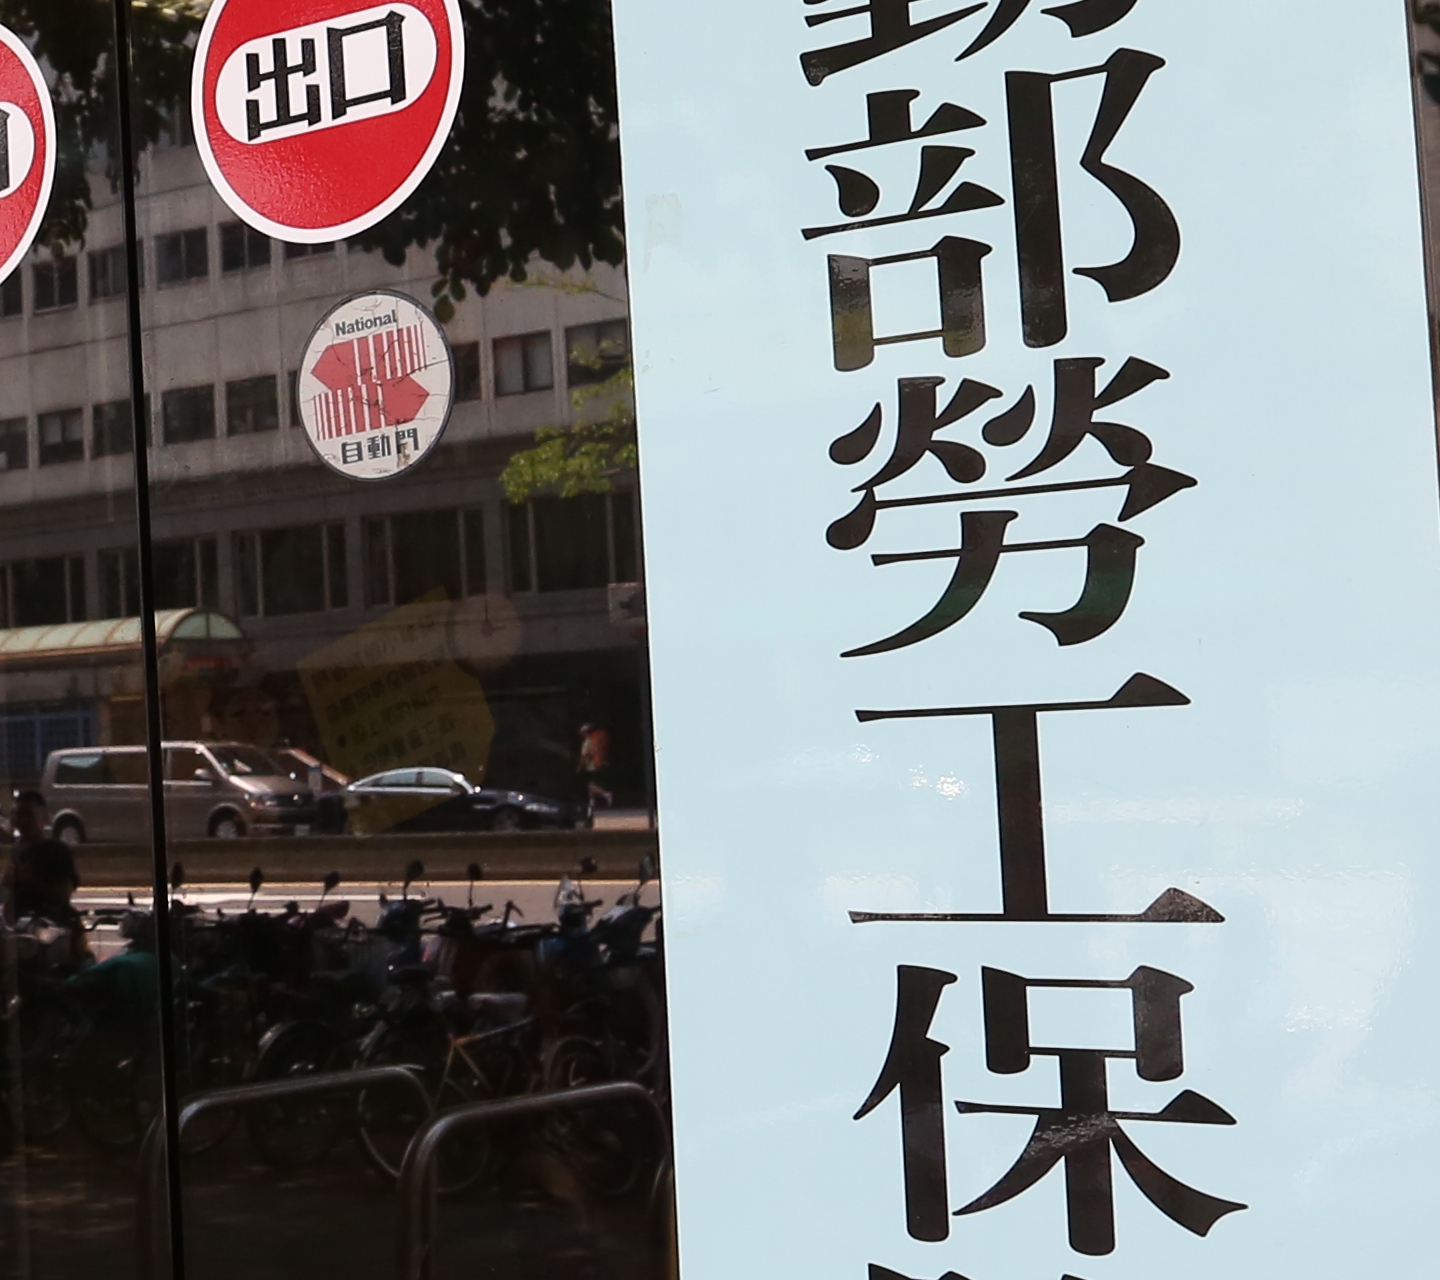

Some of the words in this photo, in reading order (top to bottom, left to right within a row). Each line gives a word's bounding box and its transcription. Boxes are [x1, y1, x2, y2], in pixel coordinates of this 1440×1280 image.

[246, 9, 406, 142] 出口
[334, 308, 397, 337] National
[340, 427, 419, 465] 自動門
